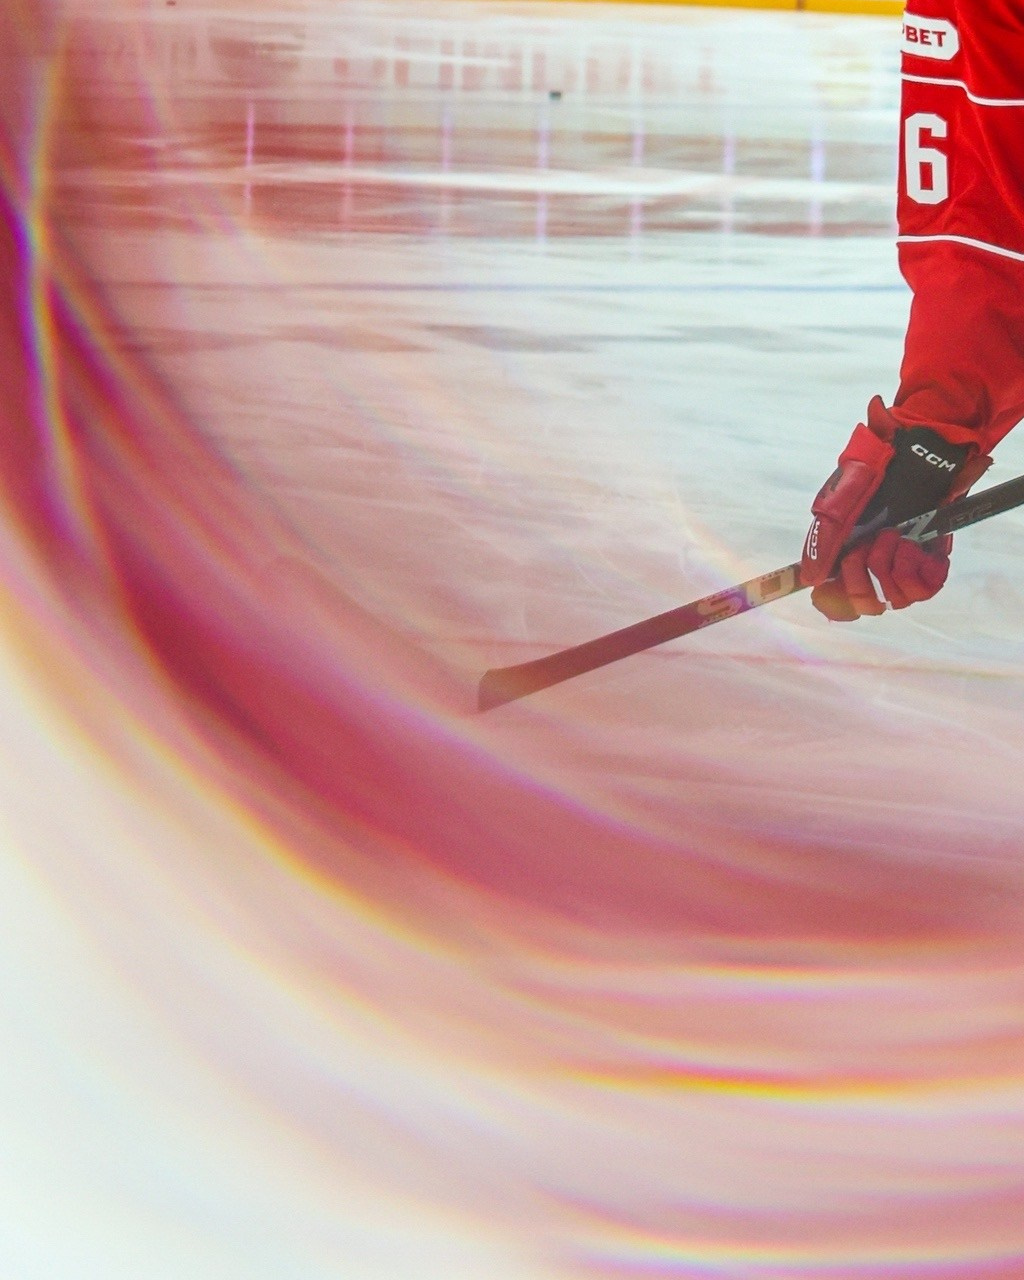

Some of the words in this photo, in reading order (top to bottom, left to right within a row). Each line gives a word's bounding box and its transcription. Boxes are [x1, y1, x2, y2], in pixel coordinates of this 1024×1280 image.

[902, 23, 946, 48] BET
[905, 113, 948, 205] 6
[911, 443, 956, 472] CCM
[810, 520, 821, 560] CCM
